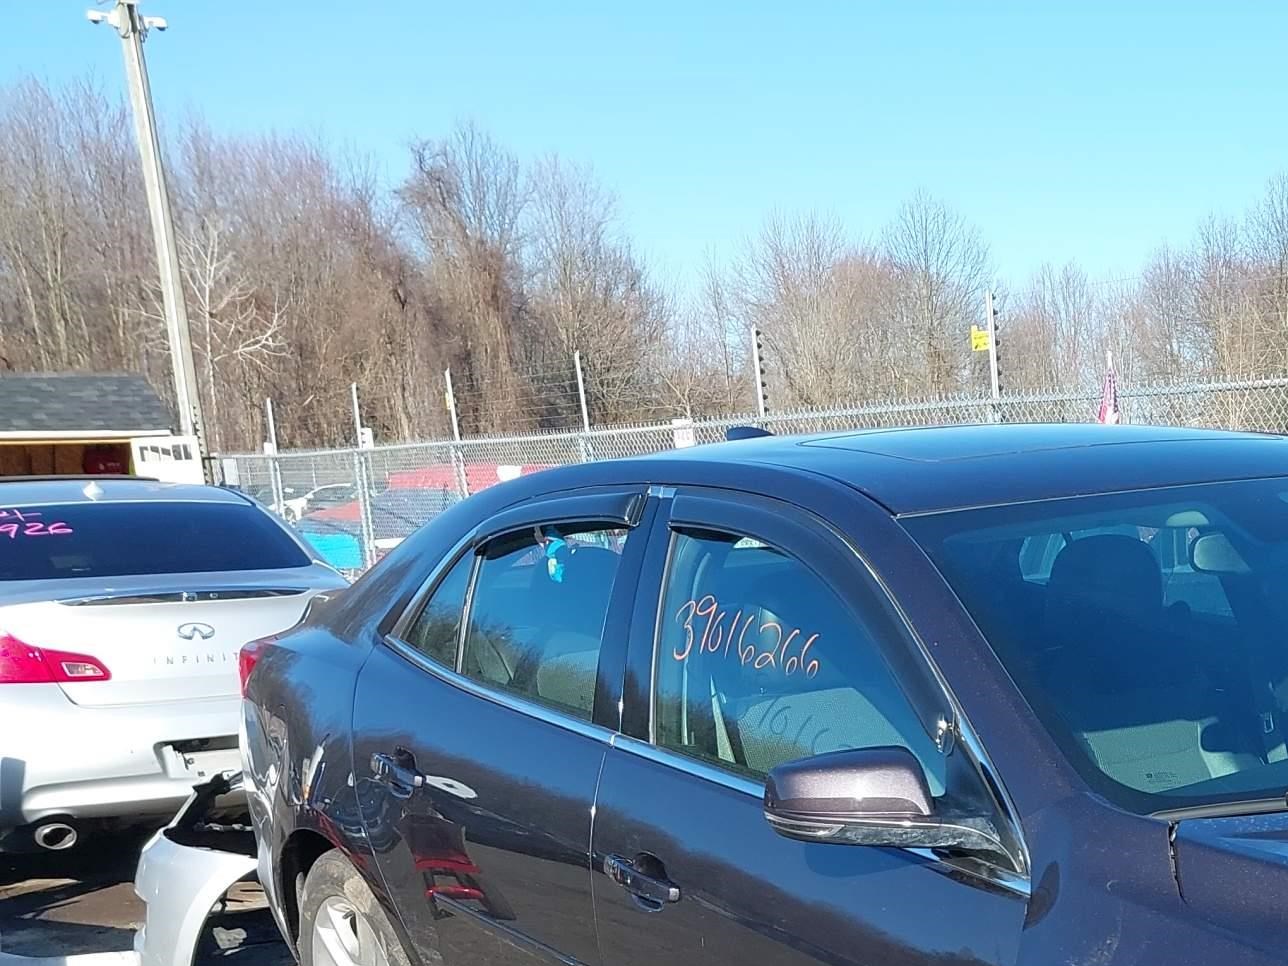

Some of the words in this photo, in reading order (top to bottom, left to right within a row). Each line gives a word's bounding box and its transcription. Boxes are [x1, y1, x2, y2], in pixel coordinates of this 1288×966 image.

[0, 521, 73, 539] 926
[672, 594, 820, 680] 39016266
[153, 652, 239, 665] INFINIT
